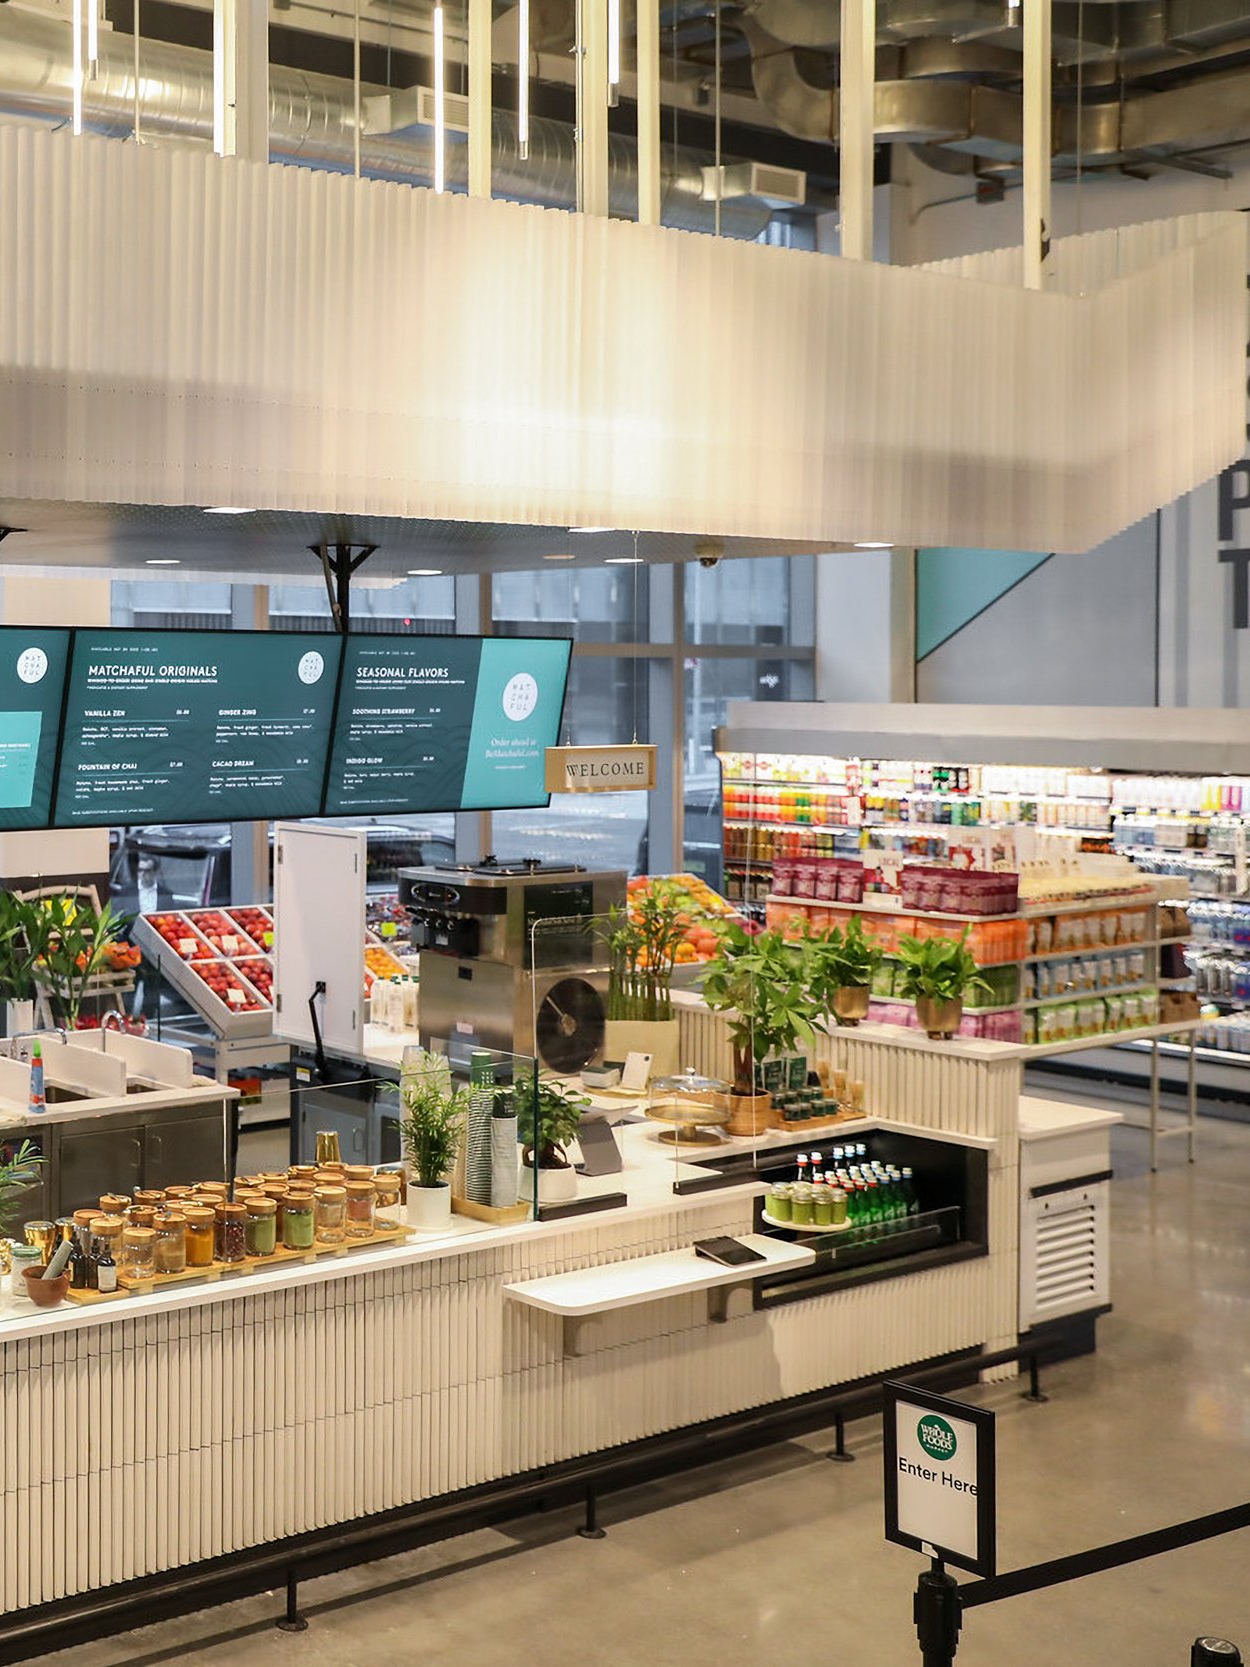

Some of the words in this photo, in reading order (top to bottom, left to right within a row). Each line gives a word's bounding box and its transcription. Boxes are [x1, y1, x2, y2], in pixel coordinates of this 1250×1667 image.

[88, 665, 156, 676] MATCHAFUL
[159, 665, 218, 676] ORIGINALS
[356, 667, 406, 678] SEASONAL
[408, 667, 449, 678] FLAVORS
[566, 761, 645, 777] WELCOME
[922, 1433, 953, 1450] FOODS
[899, 1457, 938, 1482] Enter
[941, 1470, 978, 1496] Here
